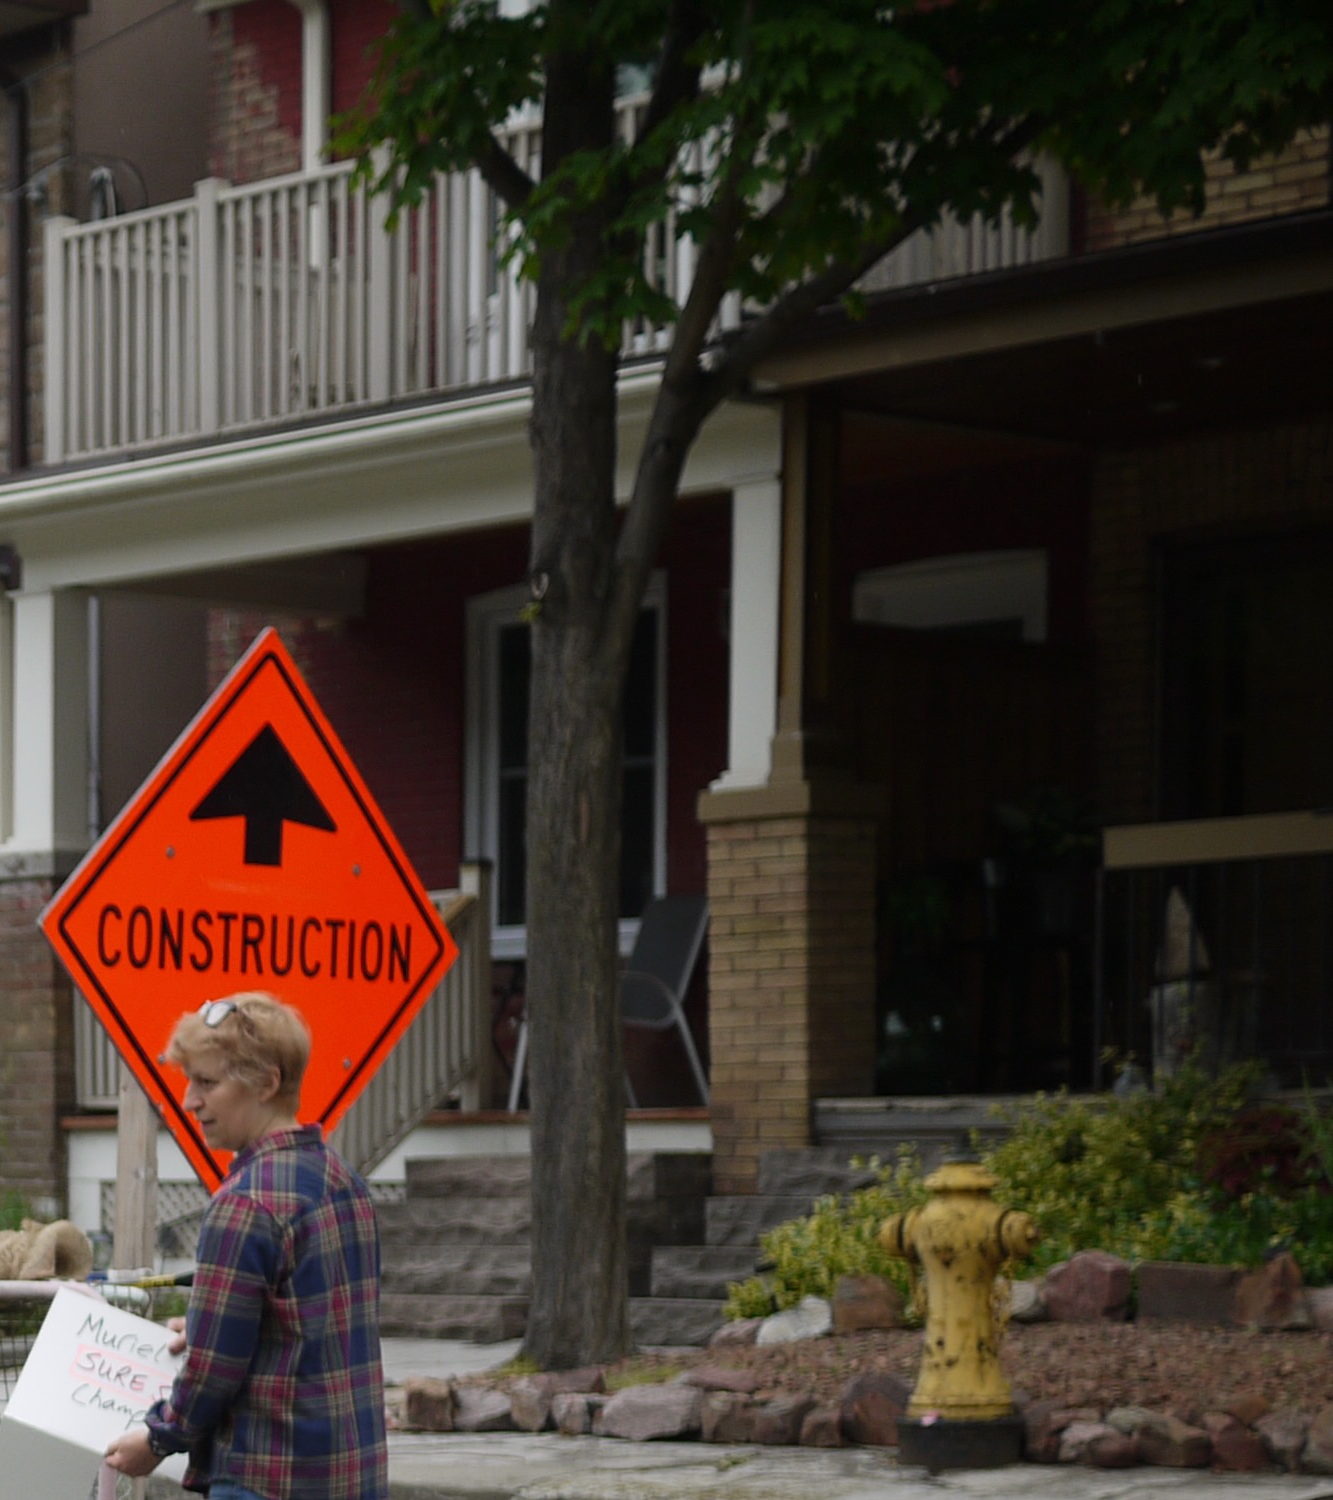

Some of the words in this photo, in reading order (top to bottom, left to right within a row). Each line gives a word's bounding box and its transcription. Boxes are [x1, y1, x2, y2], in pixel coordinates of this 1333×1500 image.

[97, 903, 412, 983] CONSTRUCTION
[76, 1312, 167, 1363] Muriel
[76, 1351, 148, 1392] SURE
